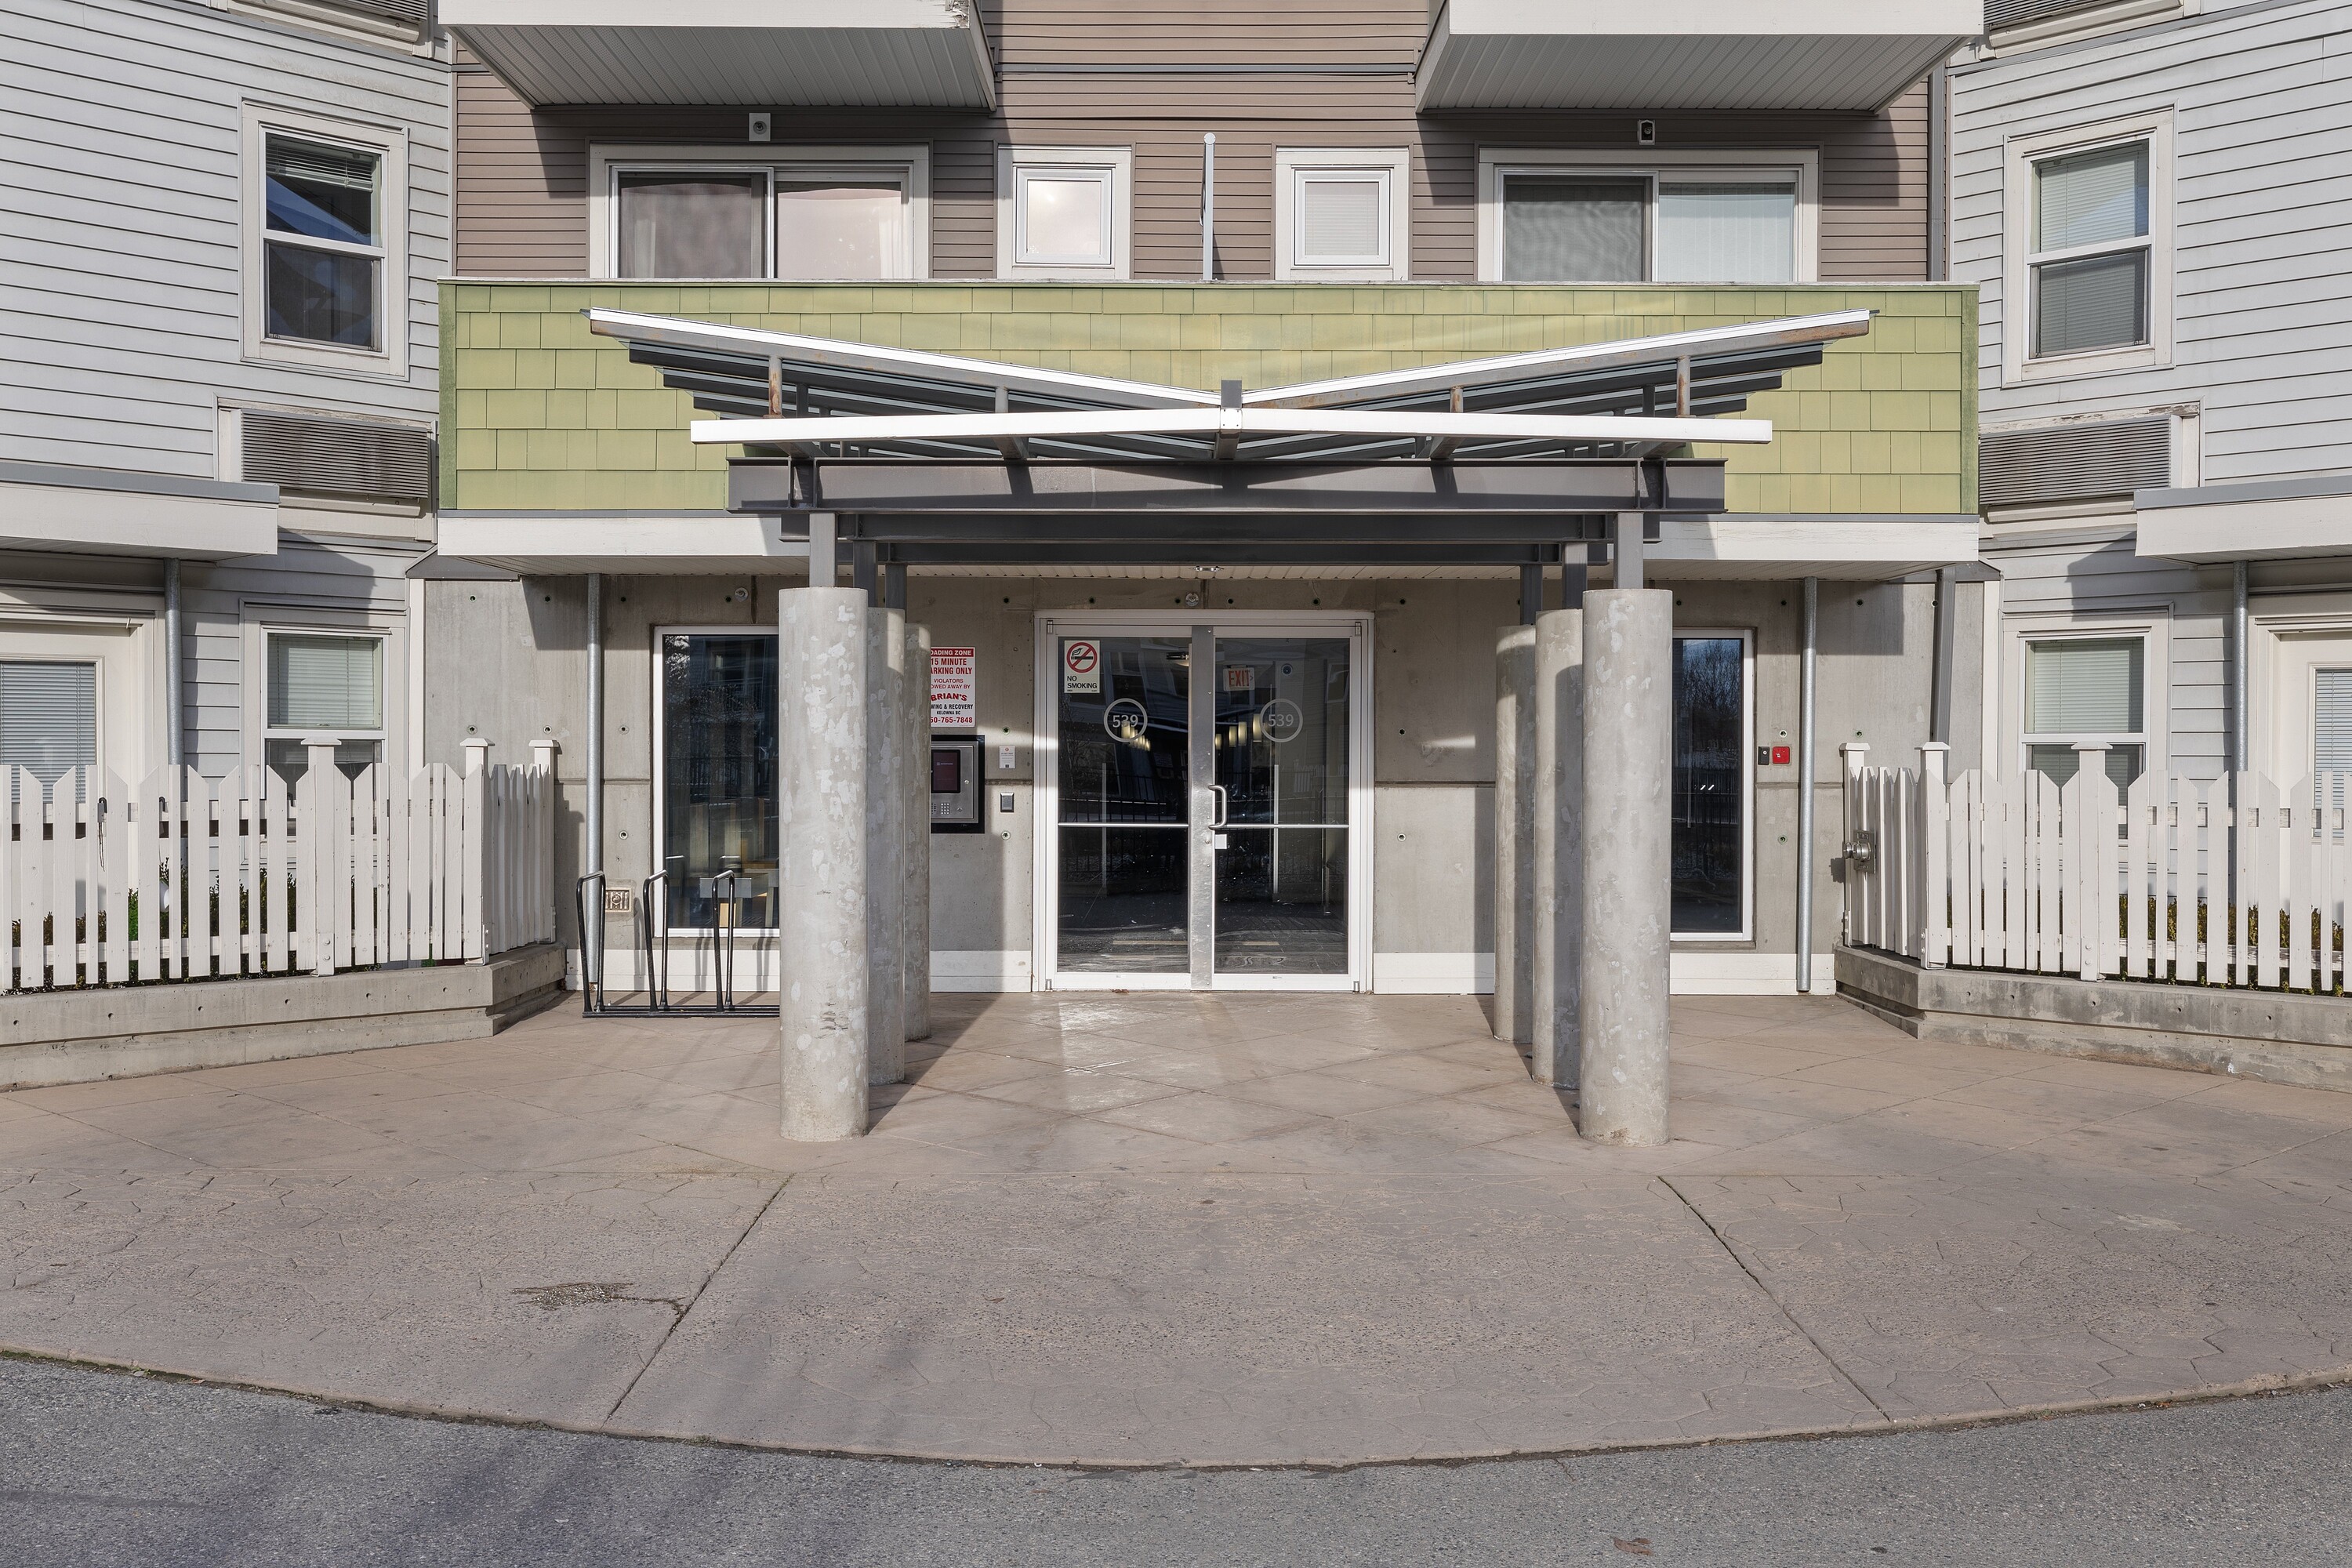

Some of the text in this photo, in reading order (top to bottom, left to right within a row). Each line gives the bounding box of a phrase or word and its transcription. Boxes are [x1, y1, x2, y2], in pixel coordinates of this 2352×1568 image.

[1229, 670, 1250, 688] EXIT
[931, 693, 967, 702] BRIAN'S
[1112, 714, 1138, 728] 539
[1268, 714, 1294, 727] 539
